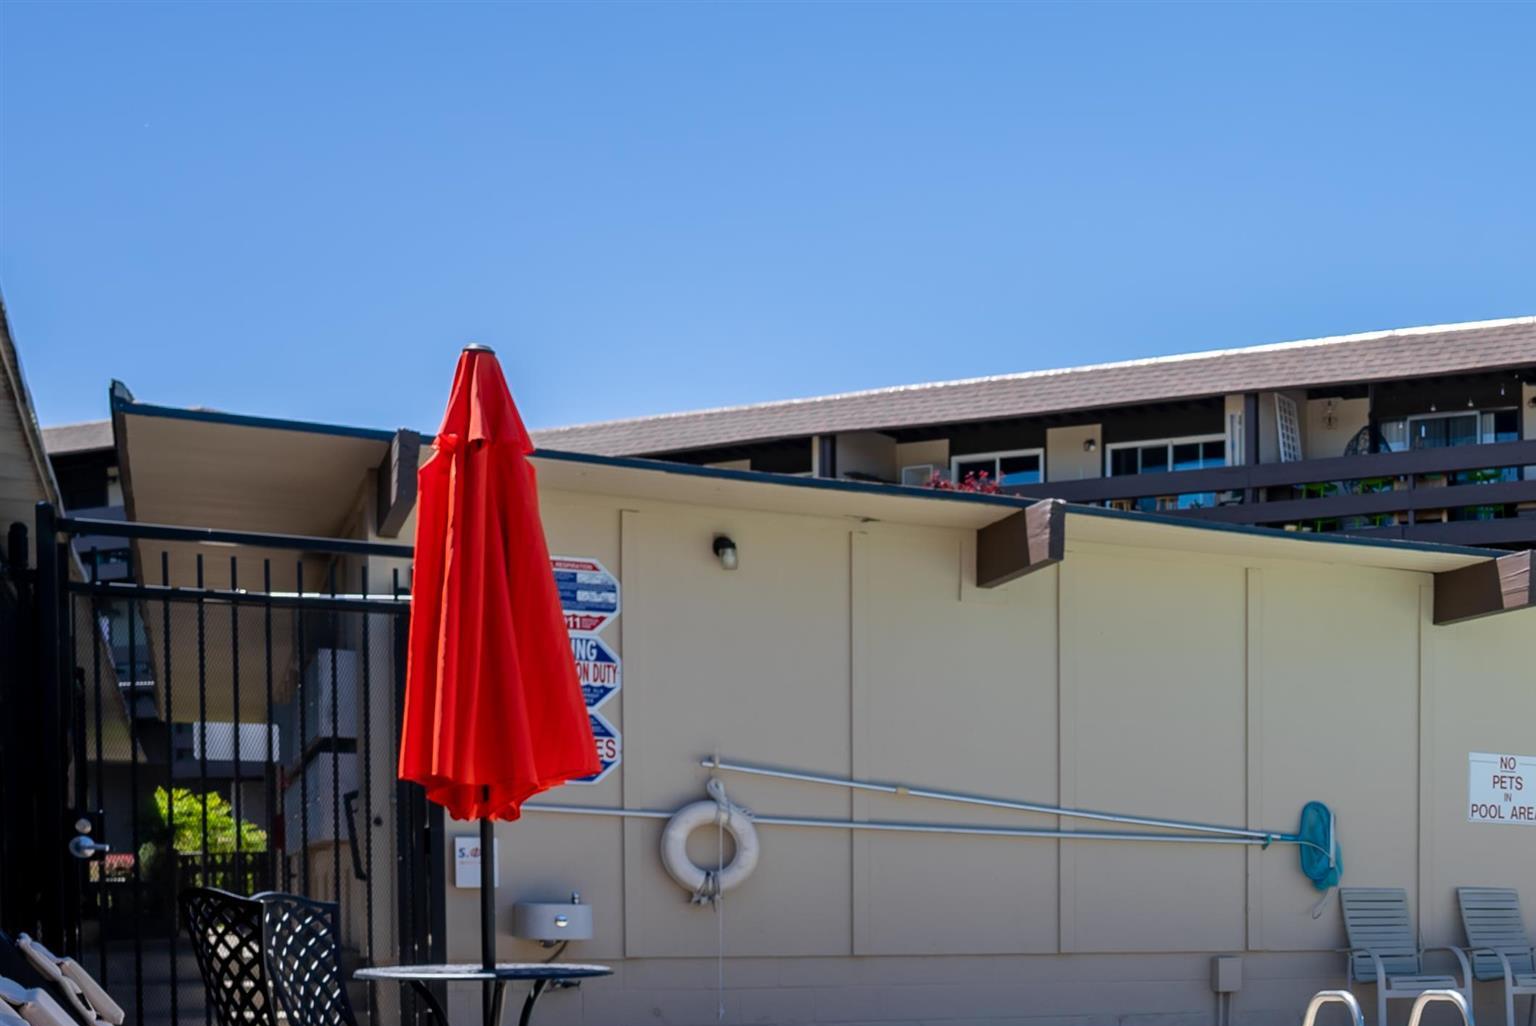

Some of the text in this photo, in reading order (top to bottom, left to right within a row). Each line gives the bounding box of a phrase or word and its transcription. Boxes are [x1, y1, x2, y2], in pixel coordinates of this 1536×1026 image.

[592, 663, 618, 684] DUTY
[1500, 756, 1517, 770] NO
[1492, 775, 1524, 791] PETS
[1504, 793, 1512, 802] IN
[1471, 804, 1505, 819] POOL
